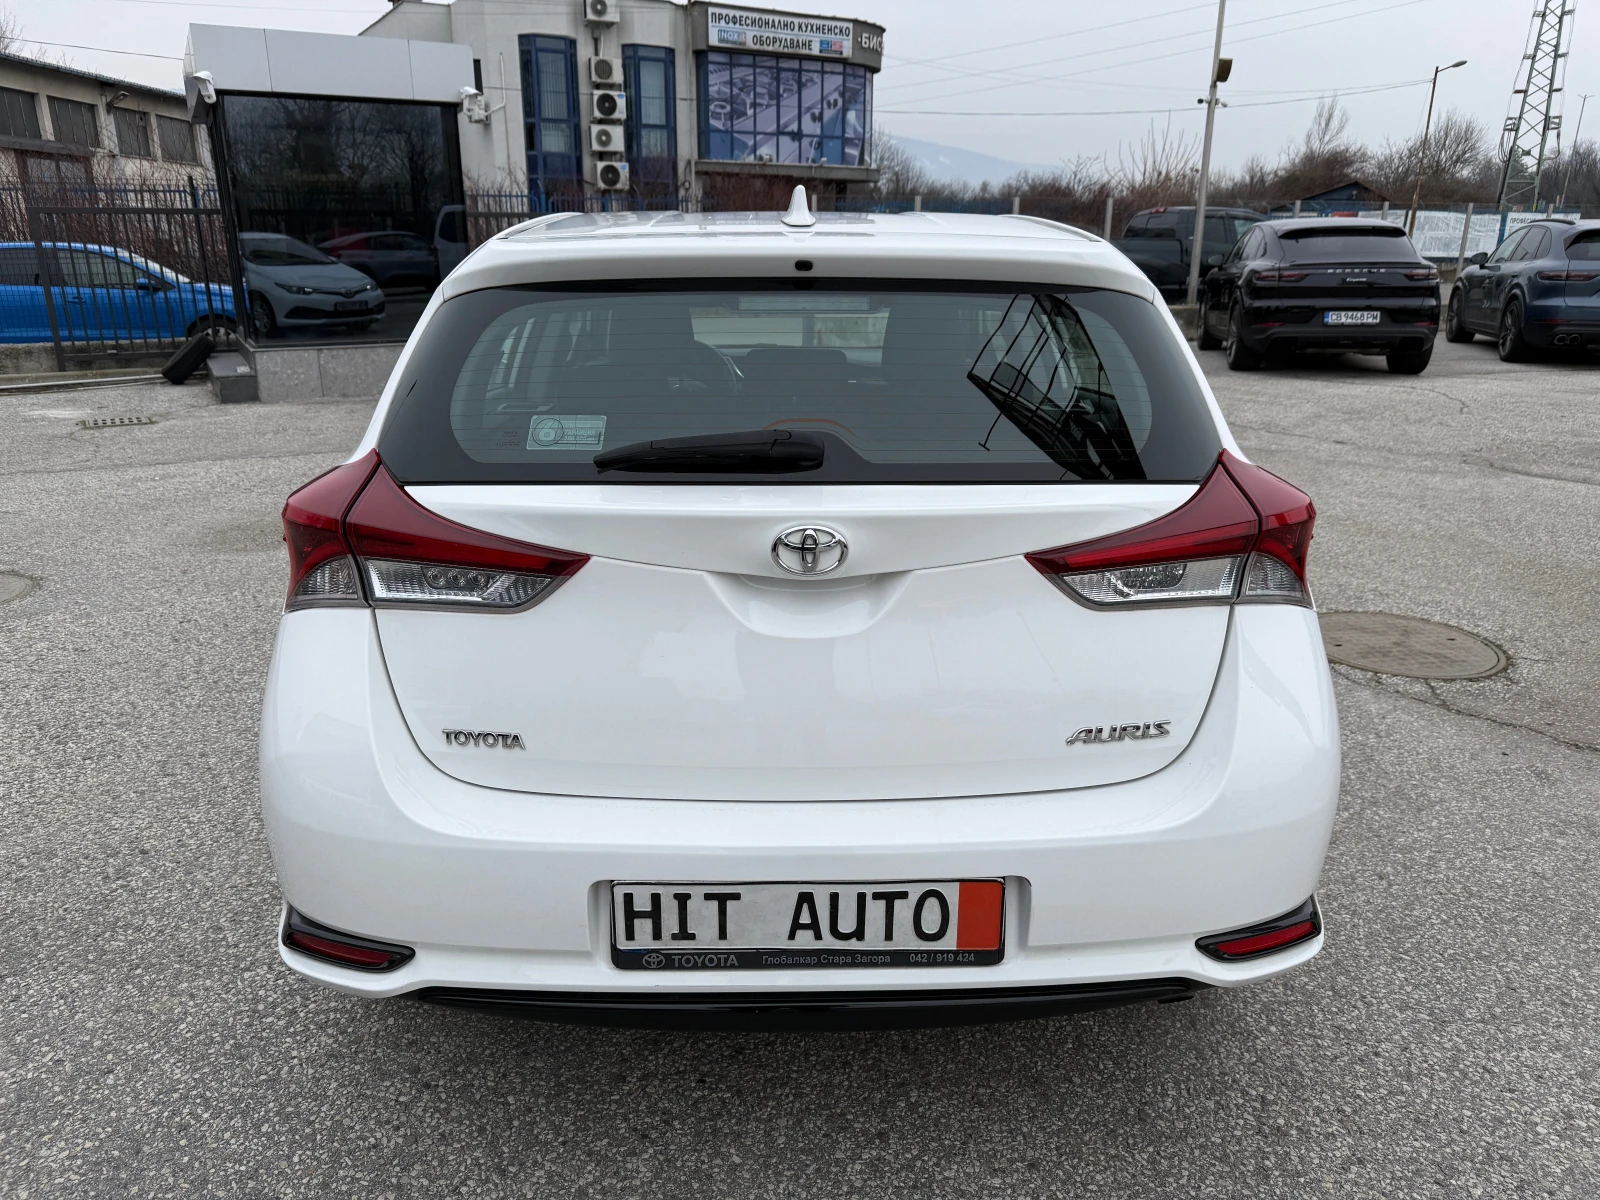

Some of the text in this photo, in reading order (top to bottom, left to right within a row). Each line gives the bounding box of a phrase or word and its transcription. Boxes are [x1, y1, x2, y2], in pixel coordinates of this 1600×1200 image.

[711, 12, 851, 37] ПРОФЕСИОНАЛНО КУХНЕНСКО
[752, 34, 813, 51] ОБОРУДВАНЕ
[1344, 312, 1365, 322] 9468
[442, 728, 526, 751] TOYOTA
[1065, 719, 1172, 746] AURIS
[622, 888, 951, 943] HIT AUTO
[671, 954, 739, 968] TOYOTA
[762, 953, 891, 965] Глобалкар Стара Загора
[909, 953, 928, 963] 042
[936, 953, 954, 962] 919
[957, 952, 975, 962] 424
